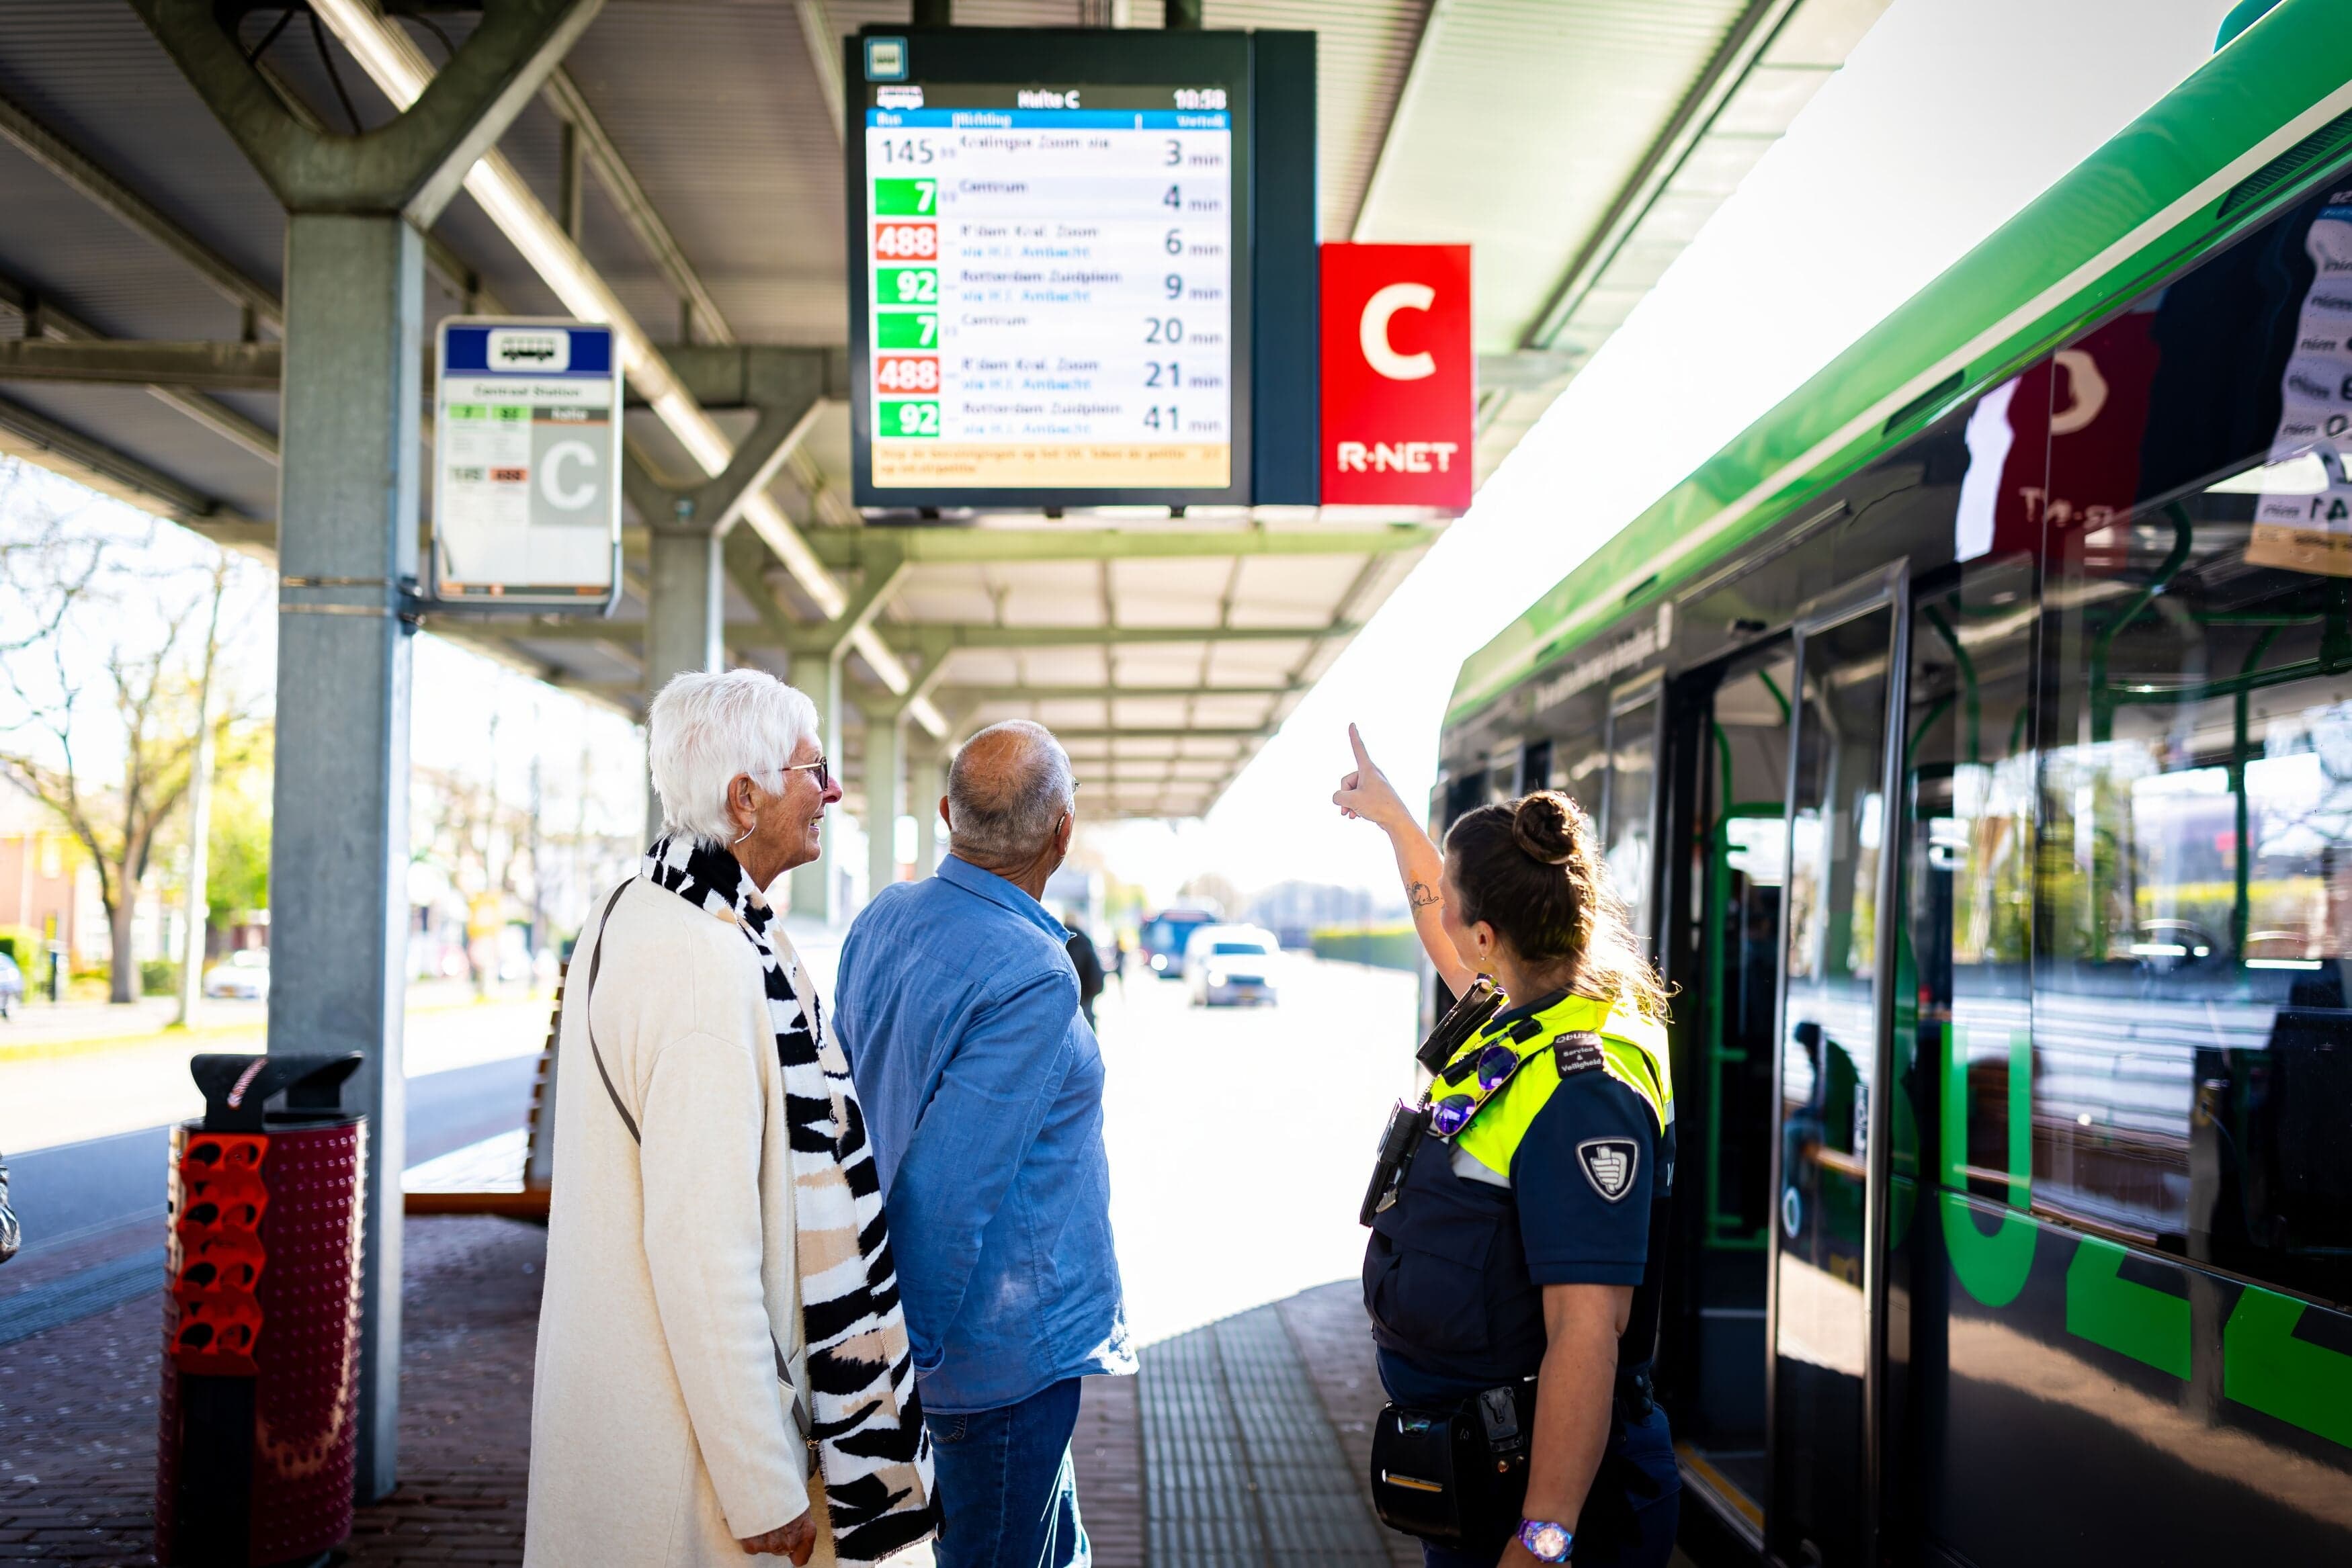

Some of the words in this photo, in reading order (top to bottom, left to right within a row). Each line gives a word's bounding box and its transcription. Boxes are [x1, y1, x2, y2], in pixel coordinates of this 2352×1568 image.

[1065, 89, 1081, 109] C
[882, 138, 934, 164] 145
[1165, 138, 1181, 166] 3
[1188, 155, 1222, 165] min
[915, 181, 935, 212] 7
[959, 179, 1026, 193] Centrum
[1163, 184, 1181, 210] 4
[1188, 200, 1222, 211] min
[878, 225, 936, 257] 488
[1166, 228, 1182, 255] 6
[1189, 245, 1222, 257] min
[896, 270, 937, 302] 92
[961, 269, 1042, 282] Rotterdam
[1050, 269, 1122, 285] Zuidplein
[1166, 273, 1182, 300] 9
[1189, 289, 1222, 300] min
[917, 315, 937, 346] 7
[1144, 317, 1183, 344] 20
[1189, 333, 1222, 345] min
[1359, 281, 1437, 381] C
[879, 359, 938, 390] 488
[1145, 361, 1179, 388] 21
[1189, 377, 1222, 388] min
[898, 404, 939, 435] 92
[962, 402, 1044, 415] Rotterdam
[1143, 404, 1179, 431] 41
[1188, 421, 1222, 432] min
[539, 439, 598, 511] C
[1562, 1058, 1601, 1072] Veiligheid
